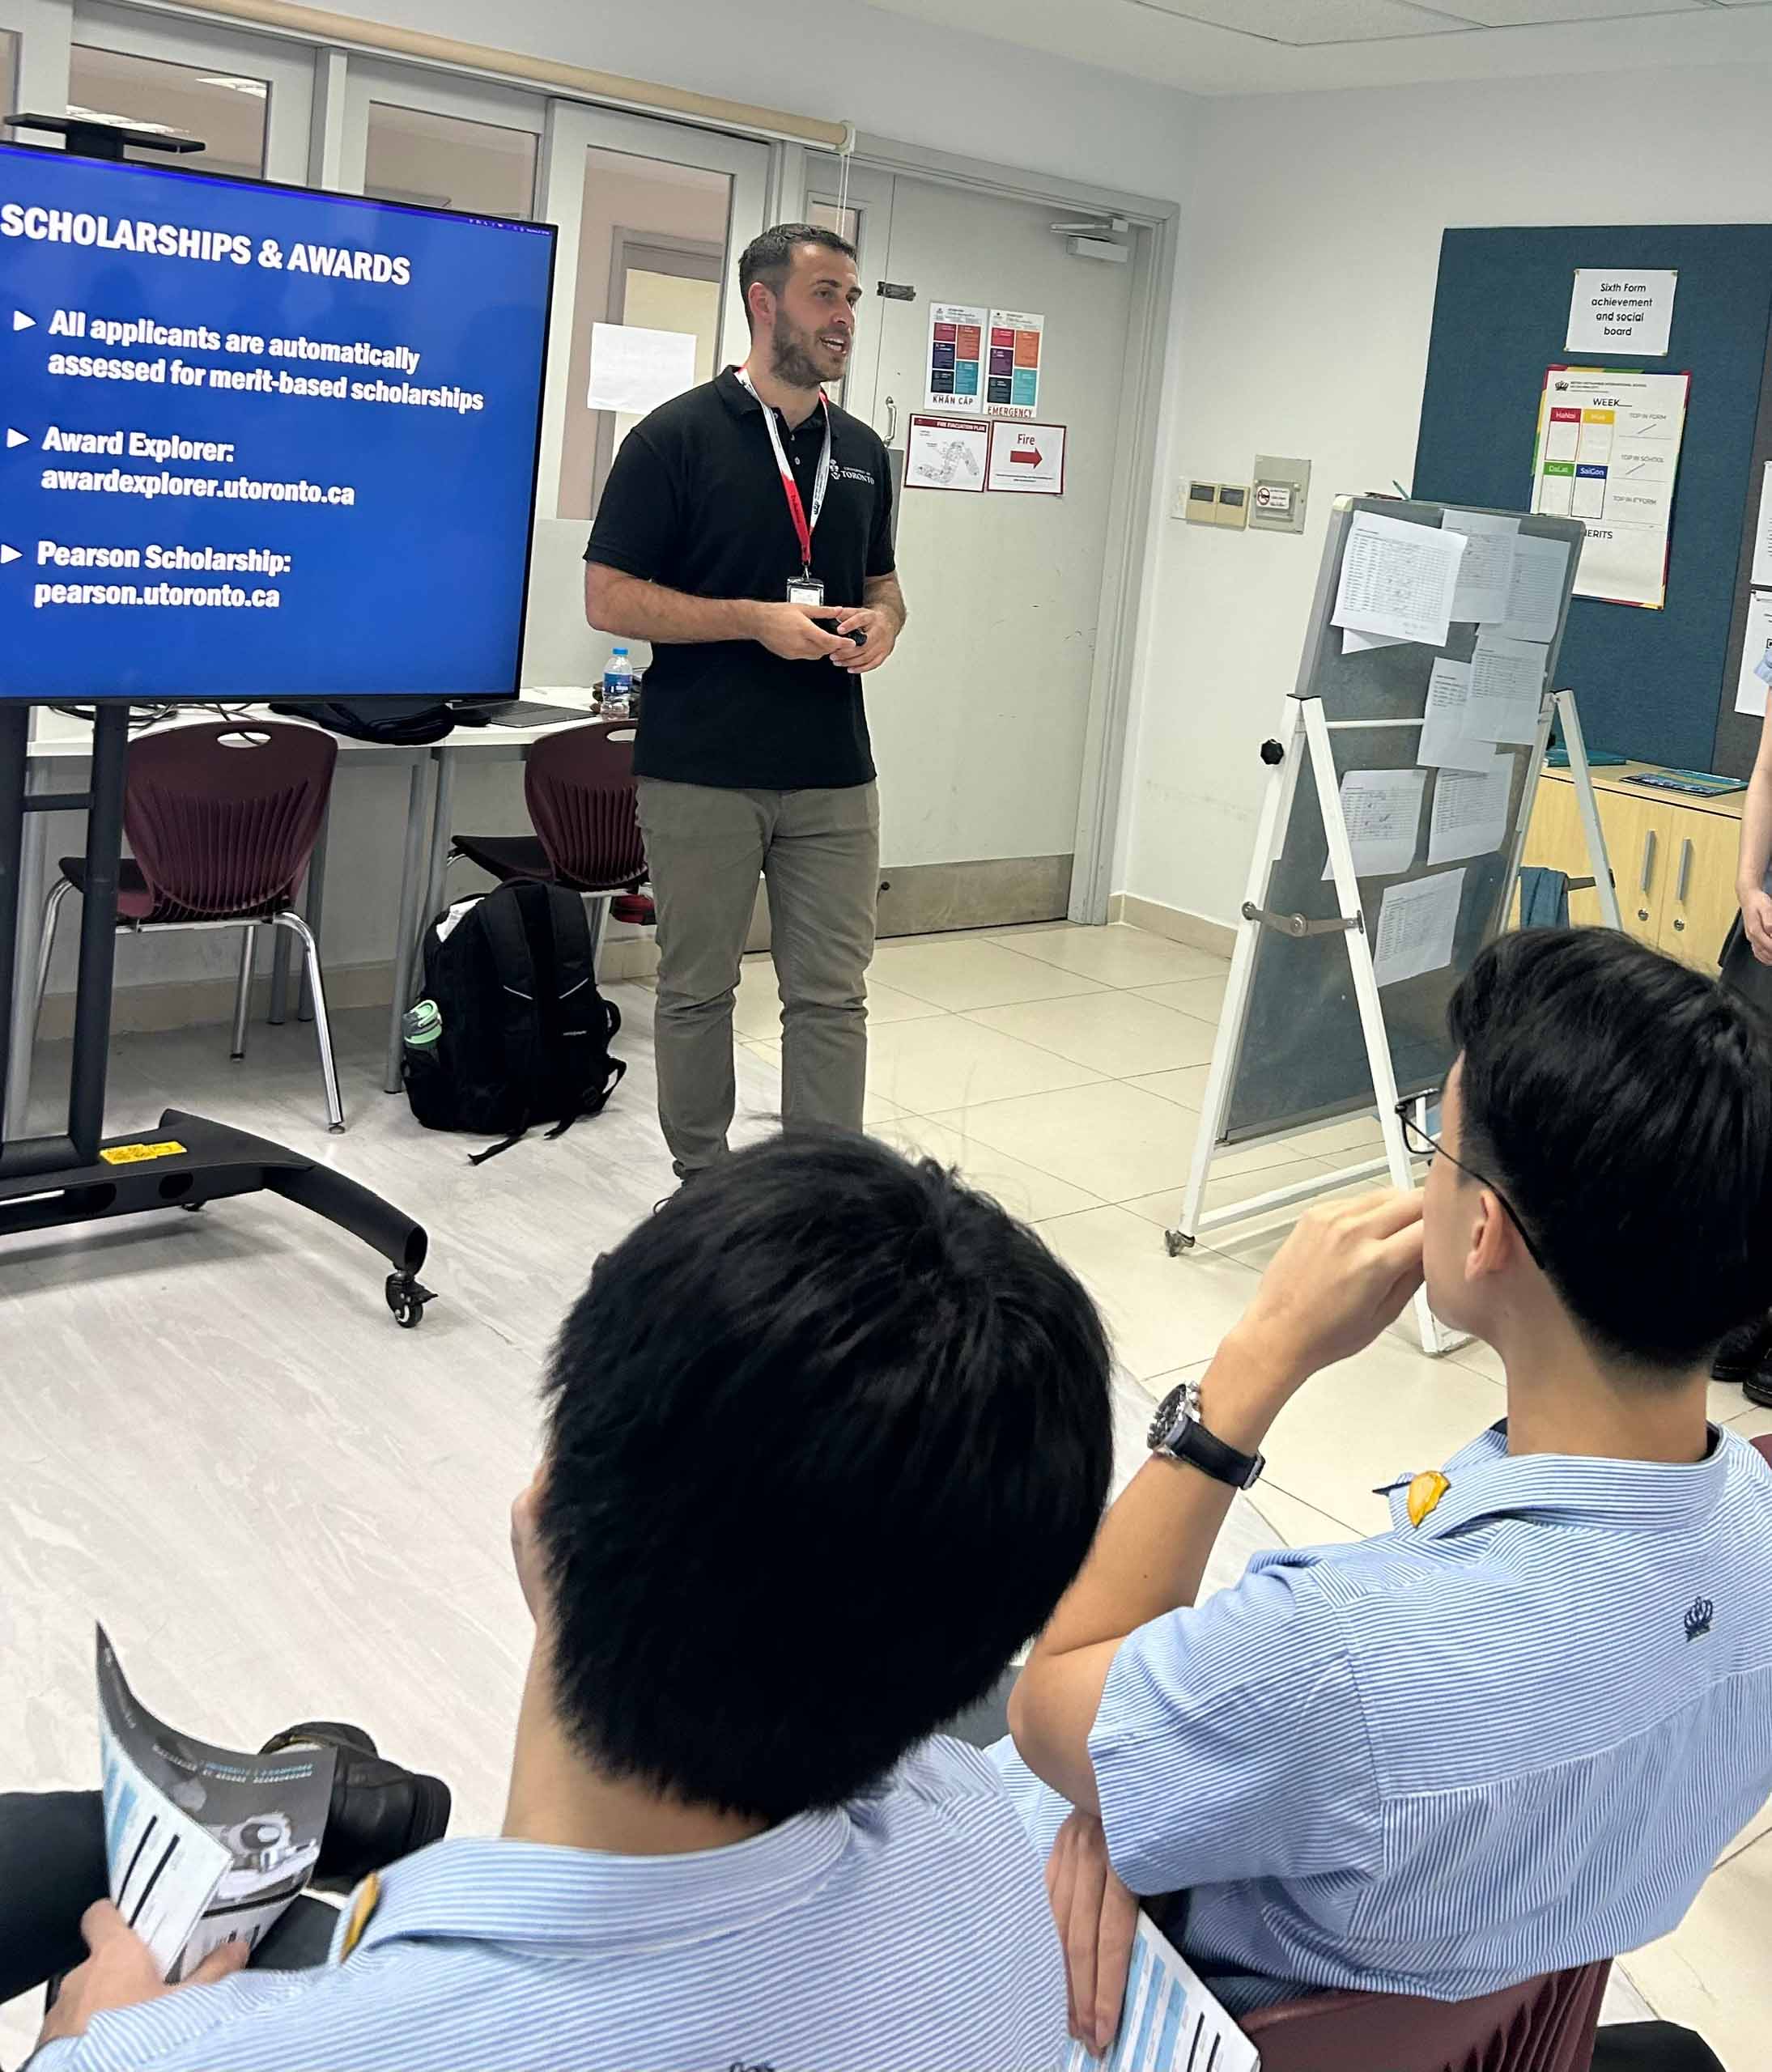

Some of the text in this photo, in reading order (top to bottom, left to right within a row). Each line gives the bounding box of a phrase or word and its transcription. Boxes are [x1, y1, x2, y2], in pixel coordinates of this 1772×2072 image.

[0, 204, 410, 286] SCHOLARSHIPS & AWARDS
[1600, 283, 1647, 292] Sixth Form
[1591, 297, 1653, 307] achievement
[1596, 312, 1644, 322] and social
[1604, 326, 1632, 336] board
[49, 310, 421, 375] All applicants are automatically
[48, 355, 484, 414] assessed for merit-based scholarships
[1593, 397, 1620, 406] WEEK
[988, 405, 1033, 418] EMERGENCY
[42, 427, 234, 462] Award Explorer:
[1017, 433, 1035, 445] Fire
[840, 470, 874, 485] TORONTO
[1580, 467, 1604, 476] SaiGon
[41, 469, 355, 506] awardexplorer.utoronto.ca
[1585, 529, 1613, 539] ERITS
[38, 541, 291, 576] Pearson Scholarship:
[34, 583, 279, 608] pearson.utoronto.ca
